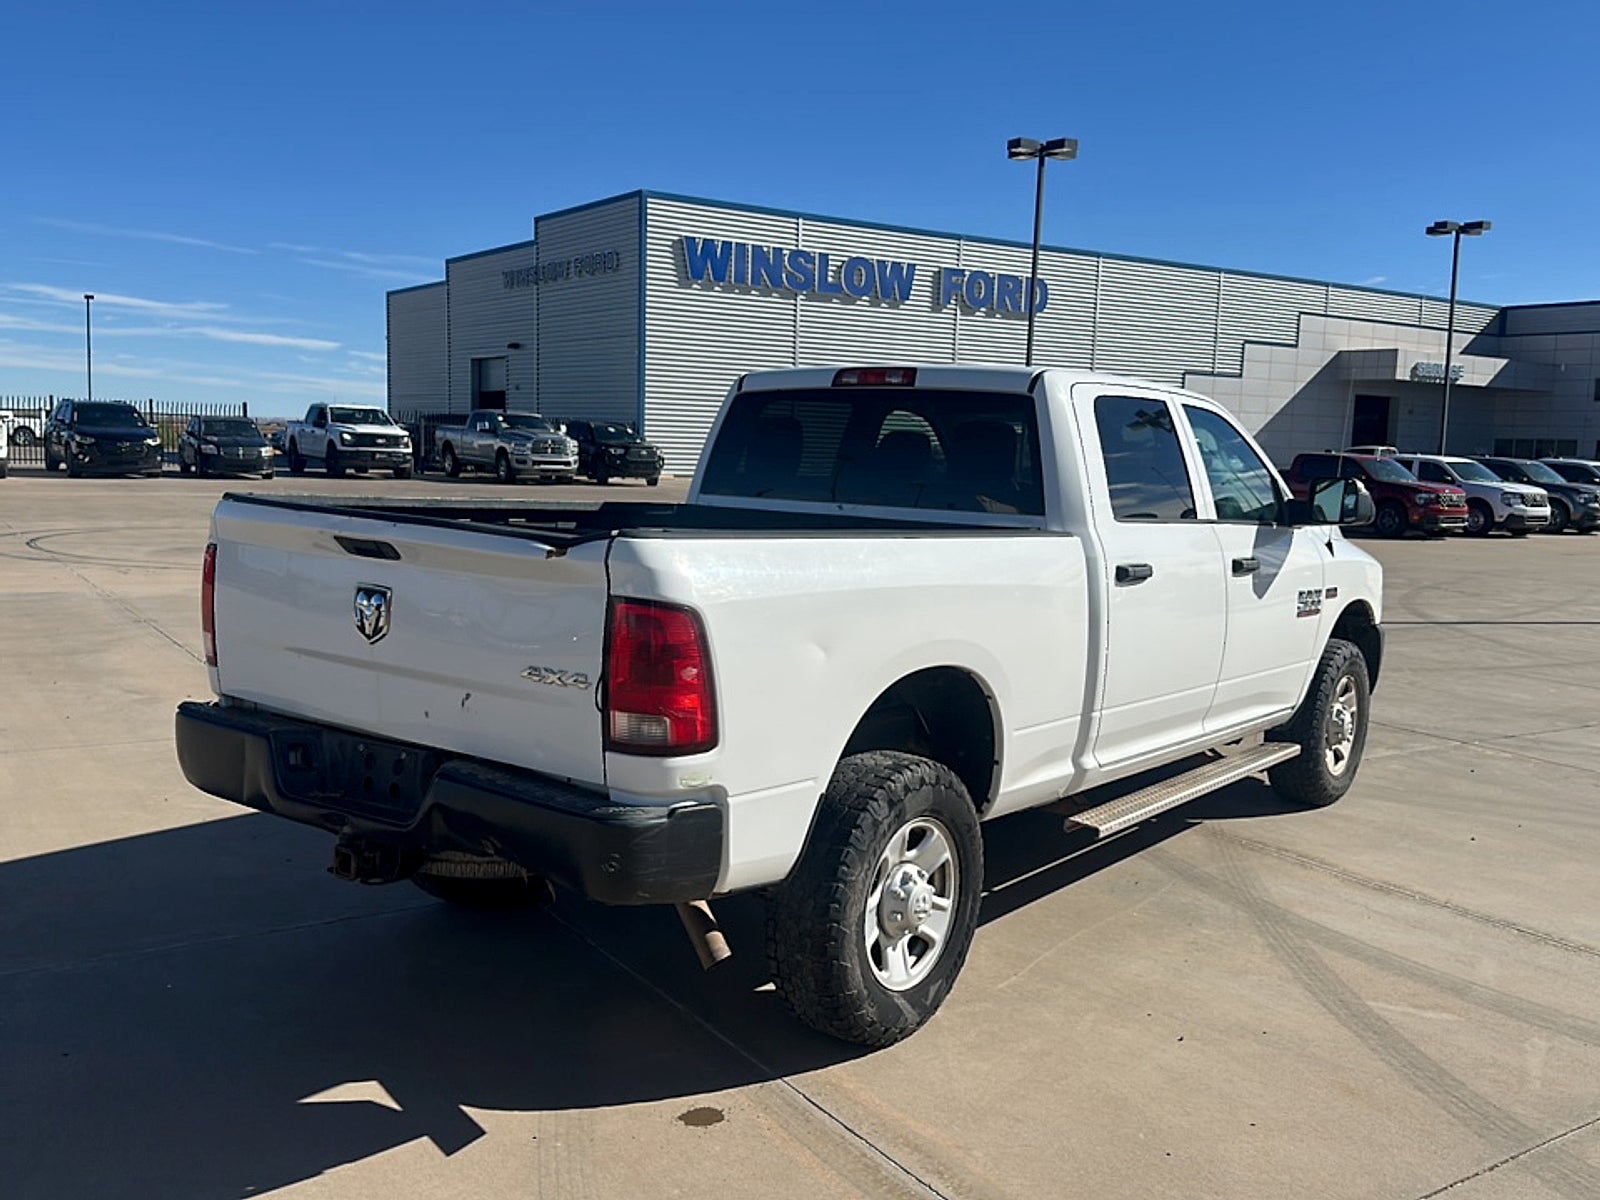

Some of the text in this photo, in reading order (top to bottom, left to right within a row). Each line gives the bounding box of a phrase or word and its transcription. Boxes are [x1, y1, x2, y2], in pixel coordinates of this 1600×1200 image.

[573, 250, 619, 278] FORD
[683, 236, 1048, 313] WINSLOW FORD
